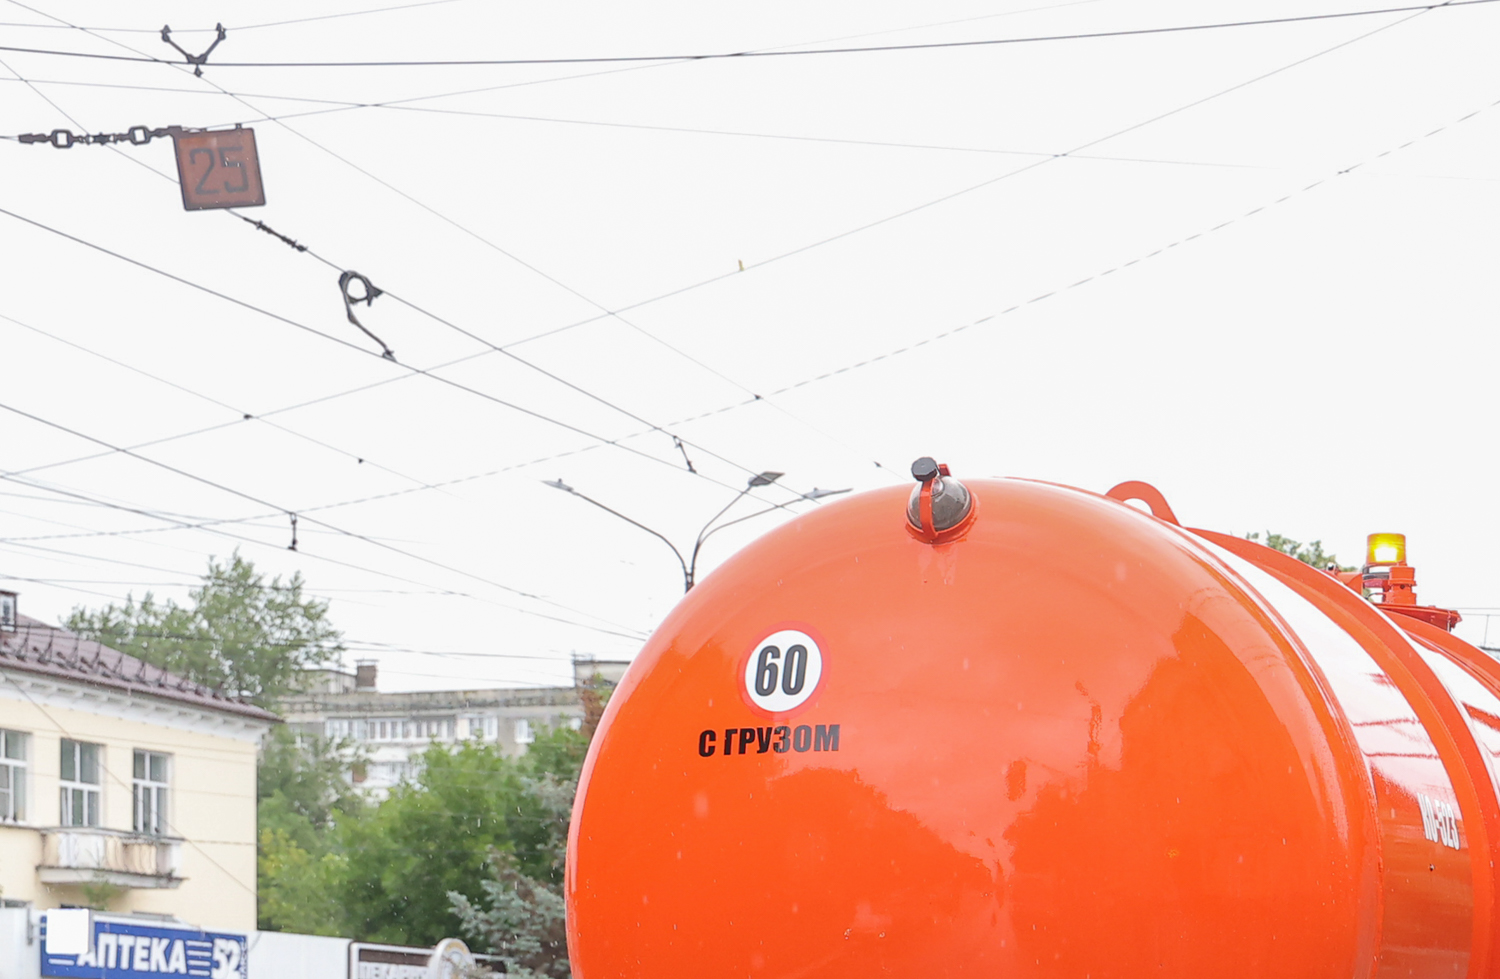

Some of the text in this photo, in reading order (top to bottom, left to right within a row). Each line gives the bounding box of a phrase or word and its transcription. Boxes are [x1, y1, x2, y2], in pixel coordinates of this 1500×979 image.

[189, 146, 249, 195] 25
[755, 644, 808, 697] 60
[698, 724, 840, 757] С ГРУЗОМ
